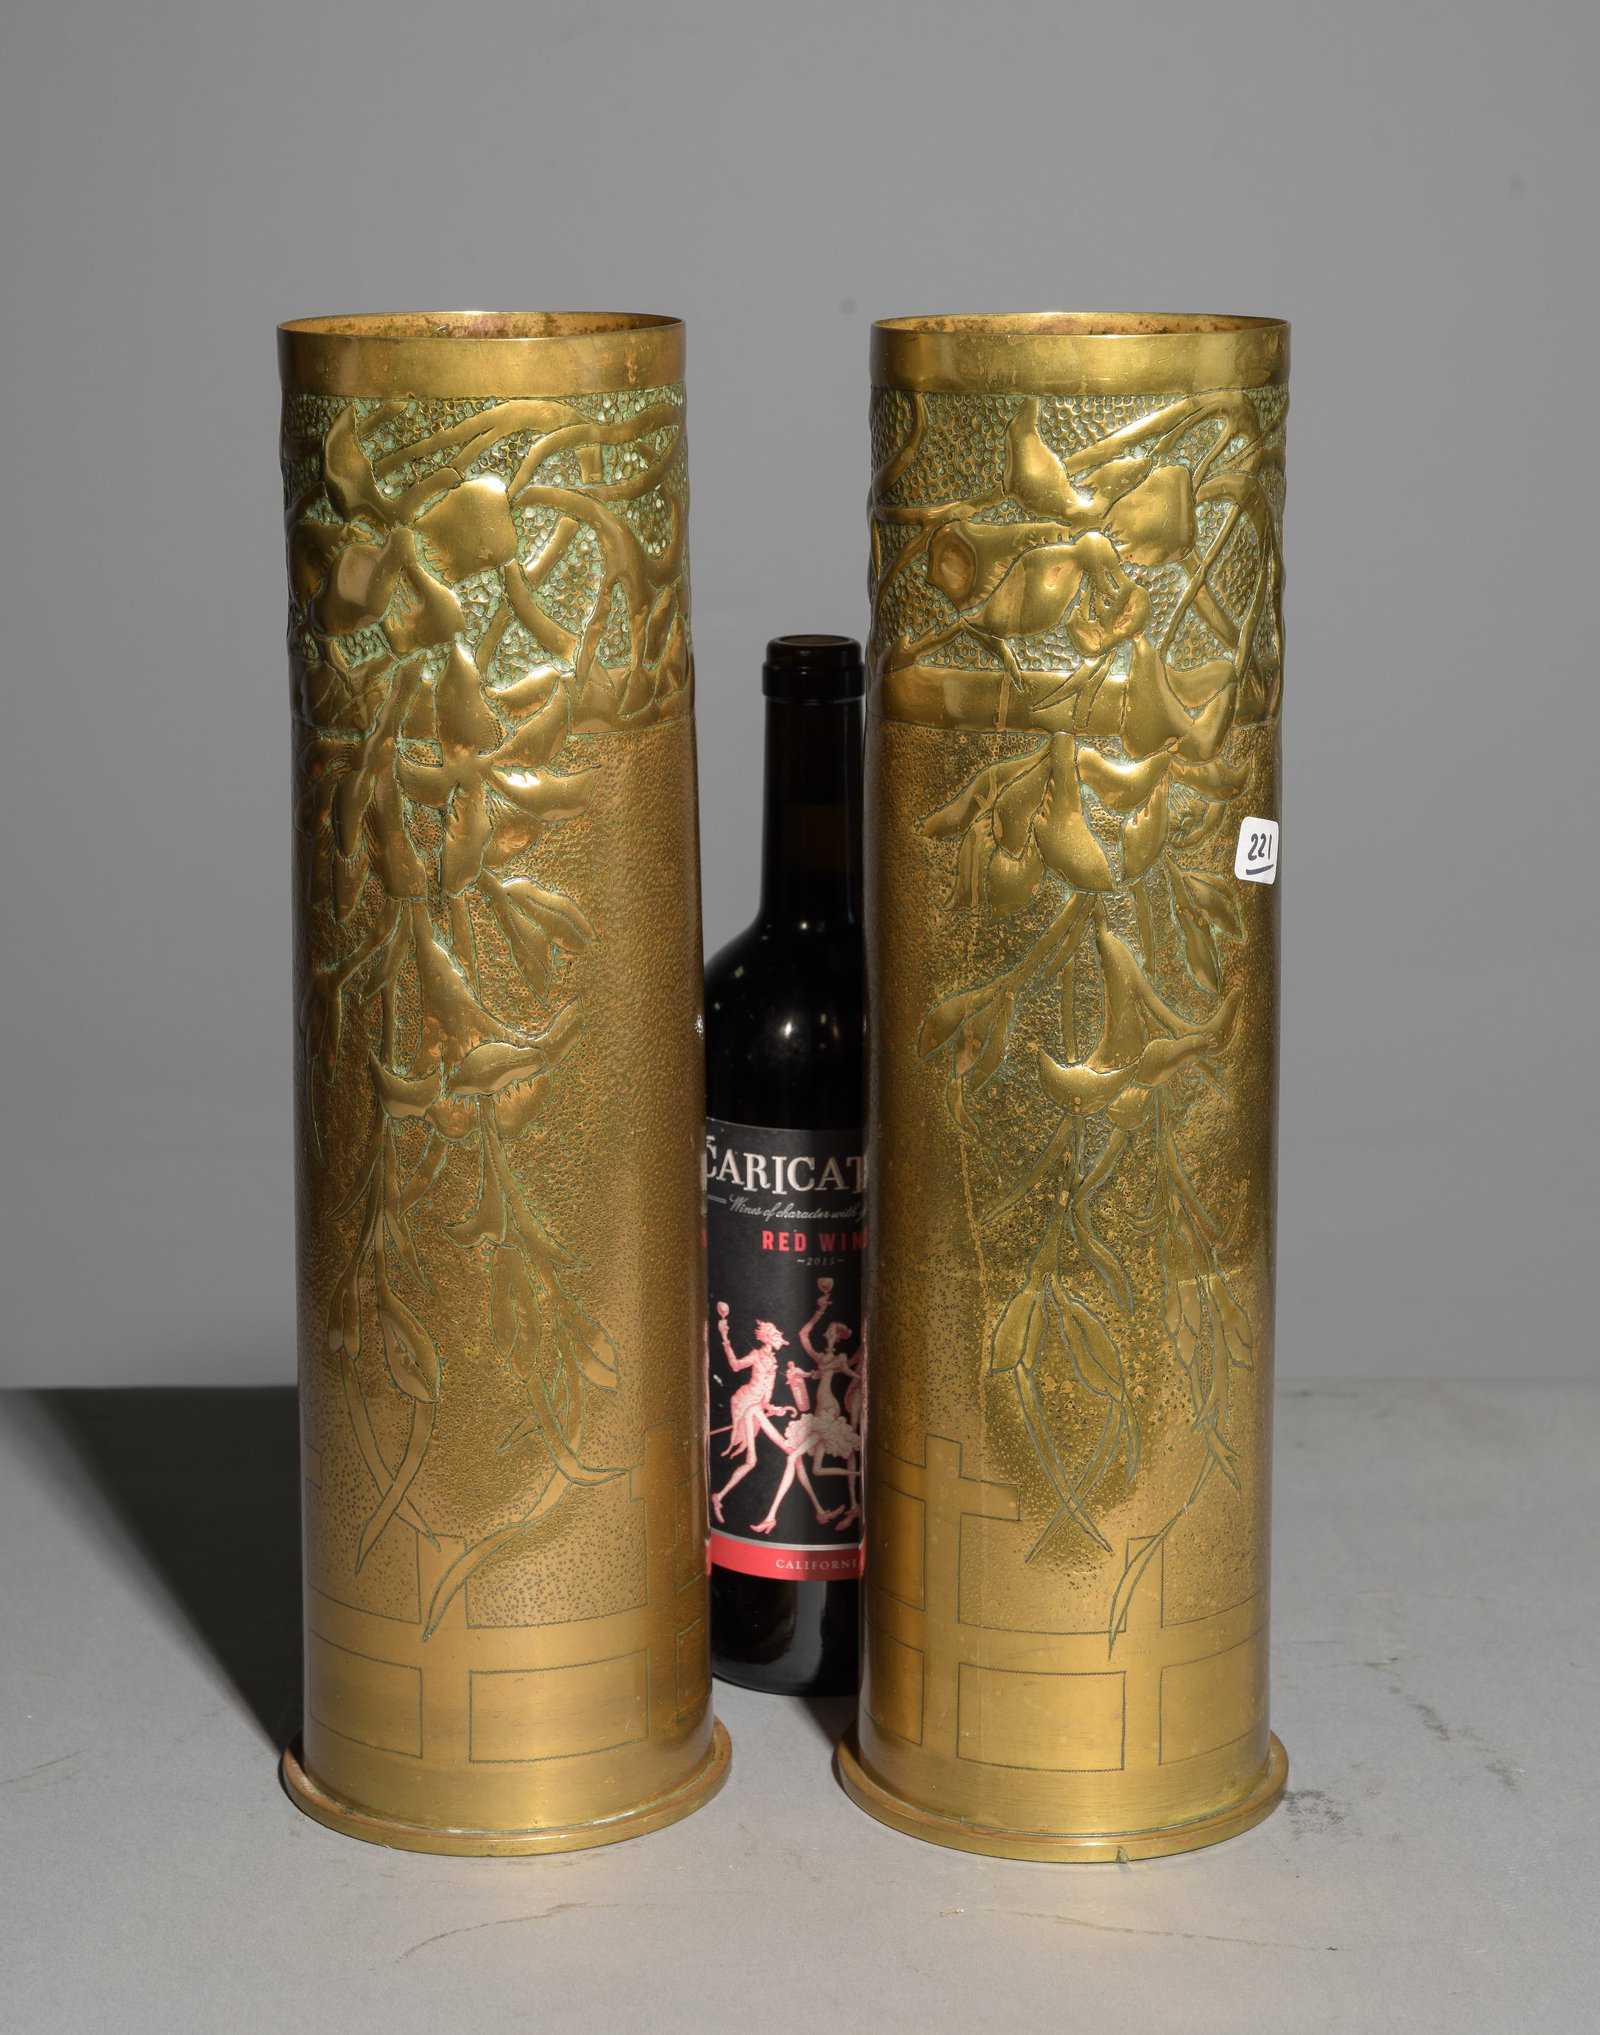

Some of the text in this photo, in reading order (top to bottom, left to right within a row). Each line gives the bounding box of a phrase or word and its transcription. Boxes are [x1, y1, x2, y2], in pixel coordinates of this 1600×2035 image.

[1248, 833, 1272, 861] 221
[729, 1194, 762, 1215] Wines
[761, 1202, 782, 1222] of
[776, 1203, 830, 1219] character
[761, 1230, 807, 1252] RED
[775, 1559, 857, 1570] CALIFORNI
